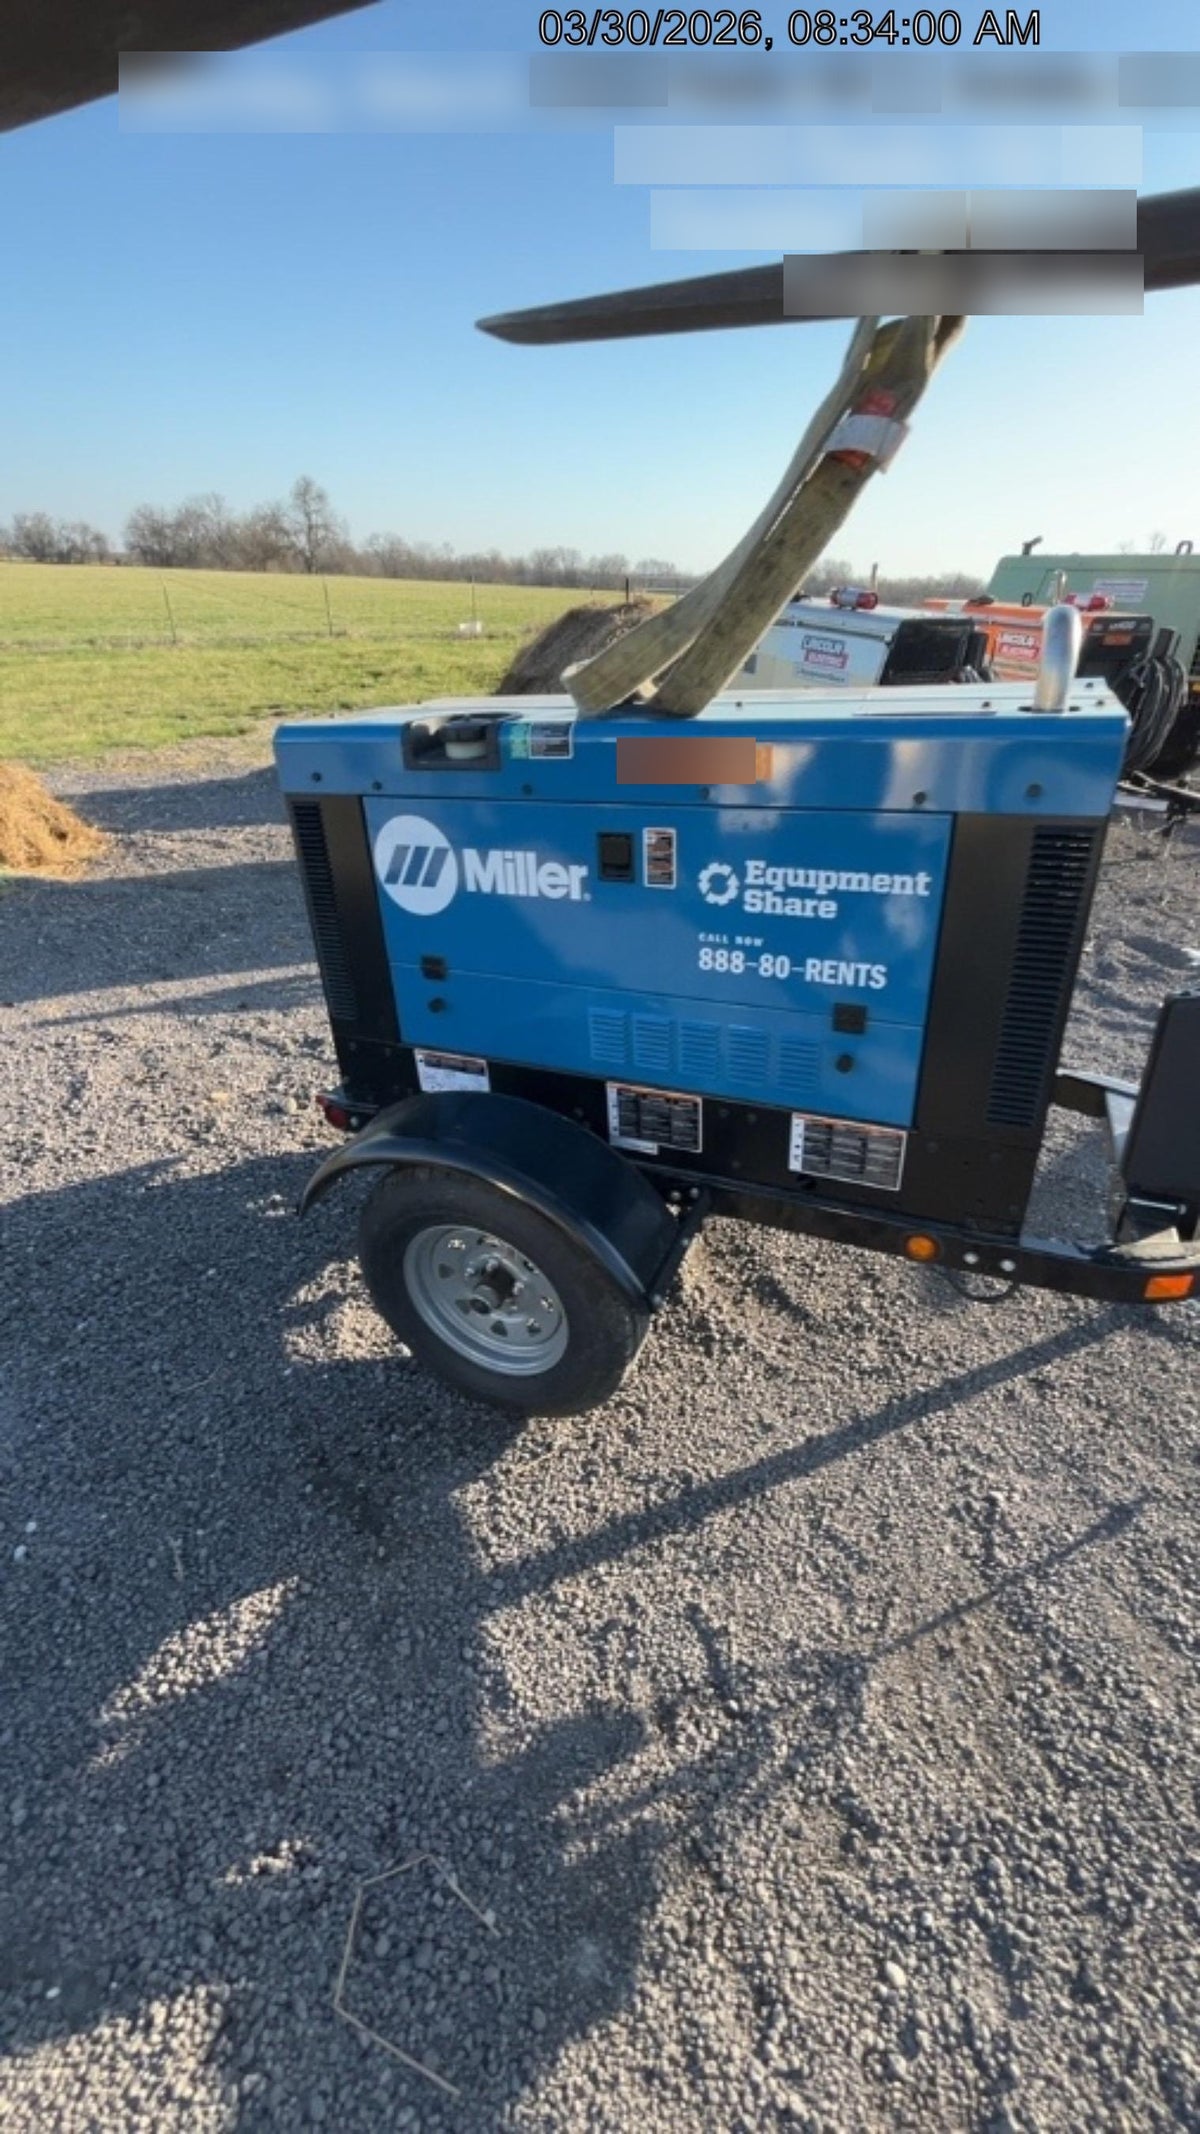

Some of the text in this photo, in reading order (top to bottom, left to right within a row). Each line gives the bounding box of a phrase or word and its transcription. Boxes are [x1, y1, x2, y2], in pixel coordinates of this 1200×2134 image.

[462, 848, 588, 901] Miller
[743, 860, 932, 898] Equipment
[743, 889, 839, 920] Share
[698, 932, 764, 947] CALL NOW
[698, 947, 888, 990] 888-80-RENTS
